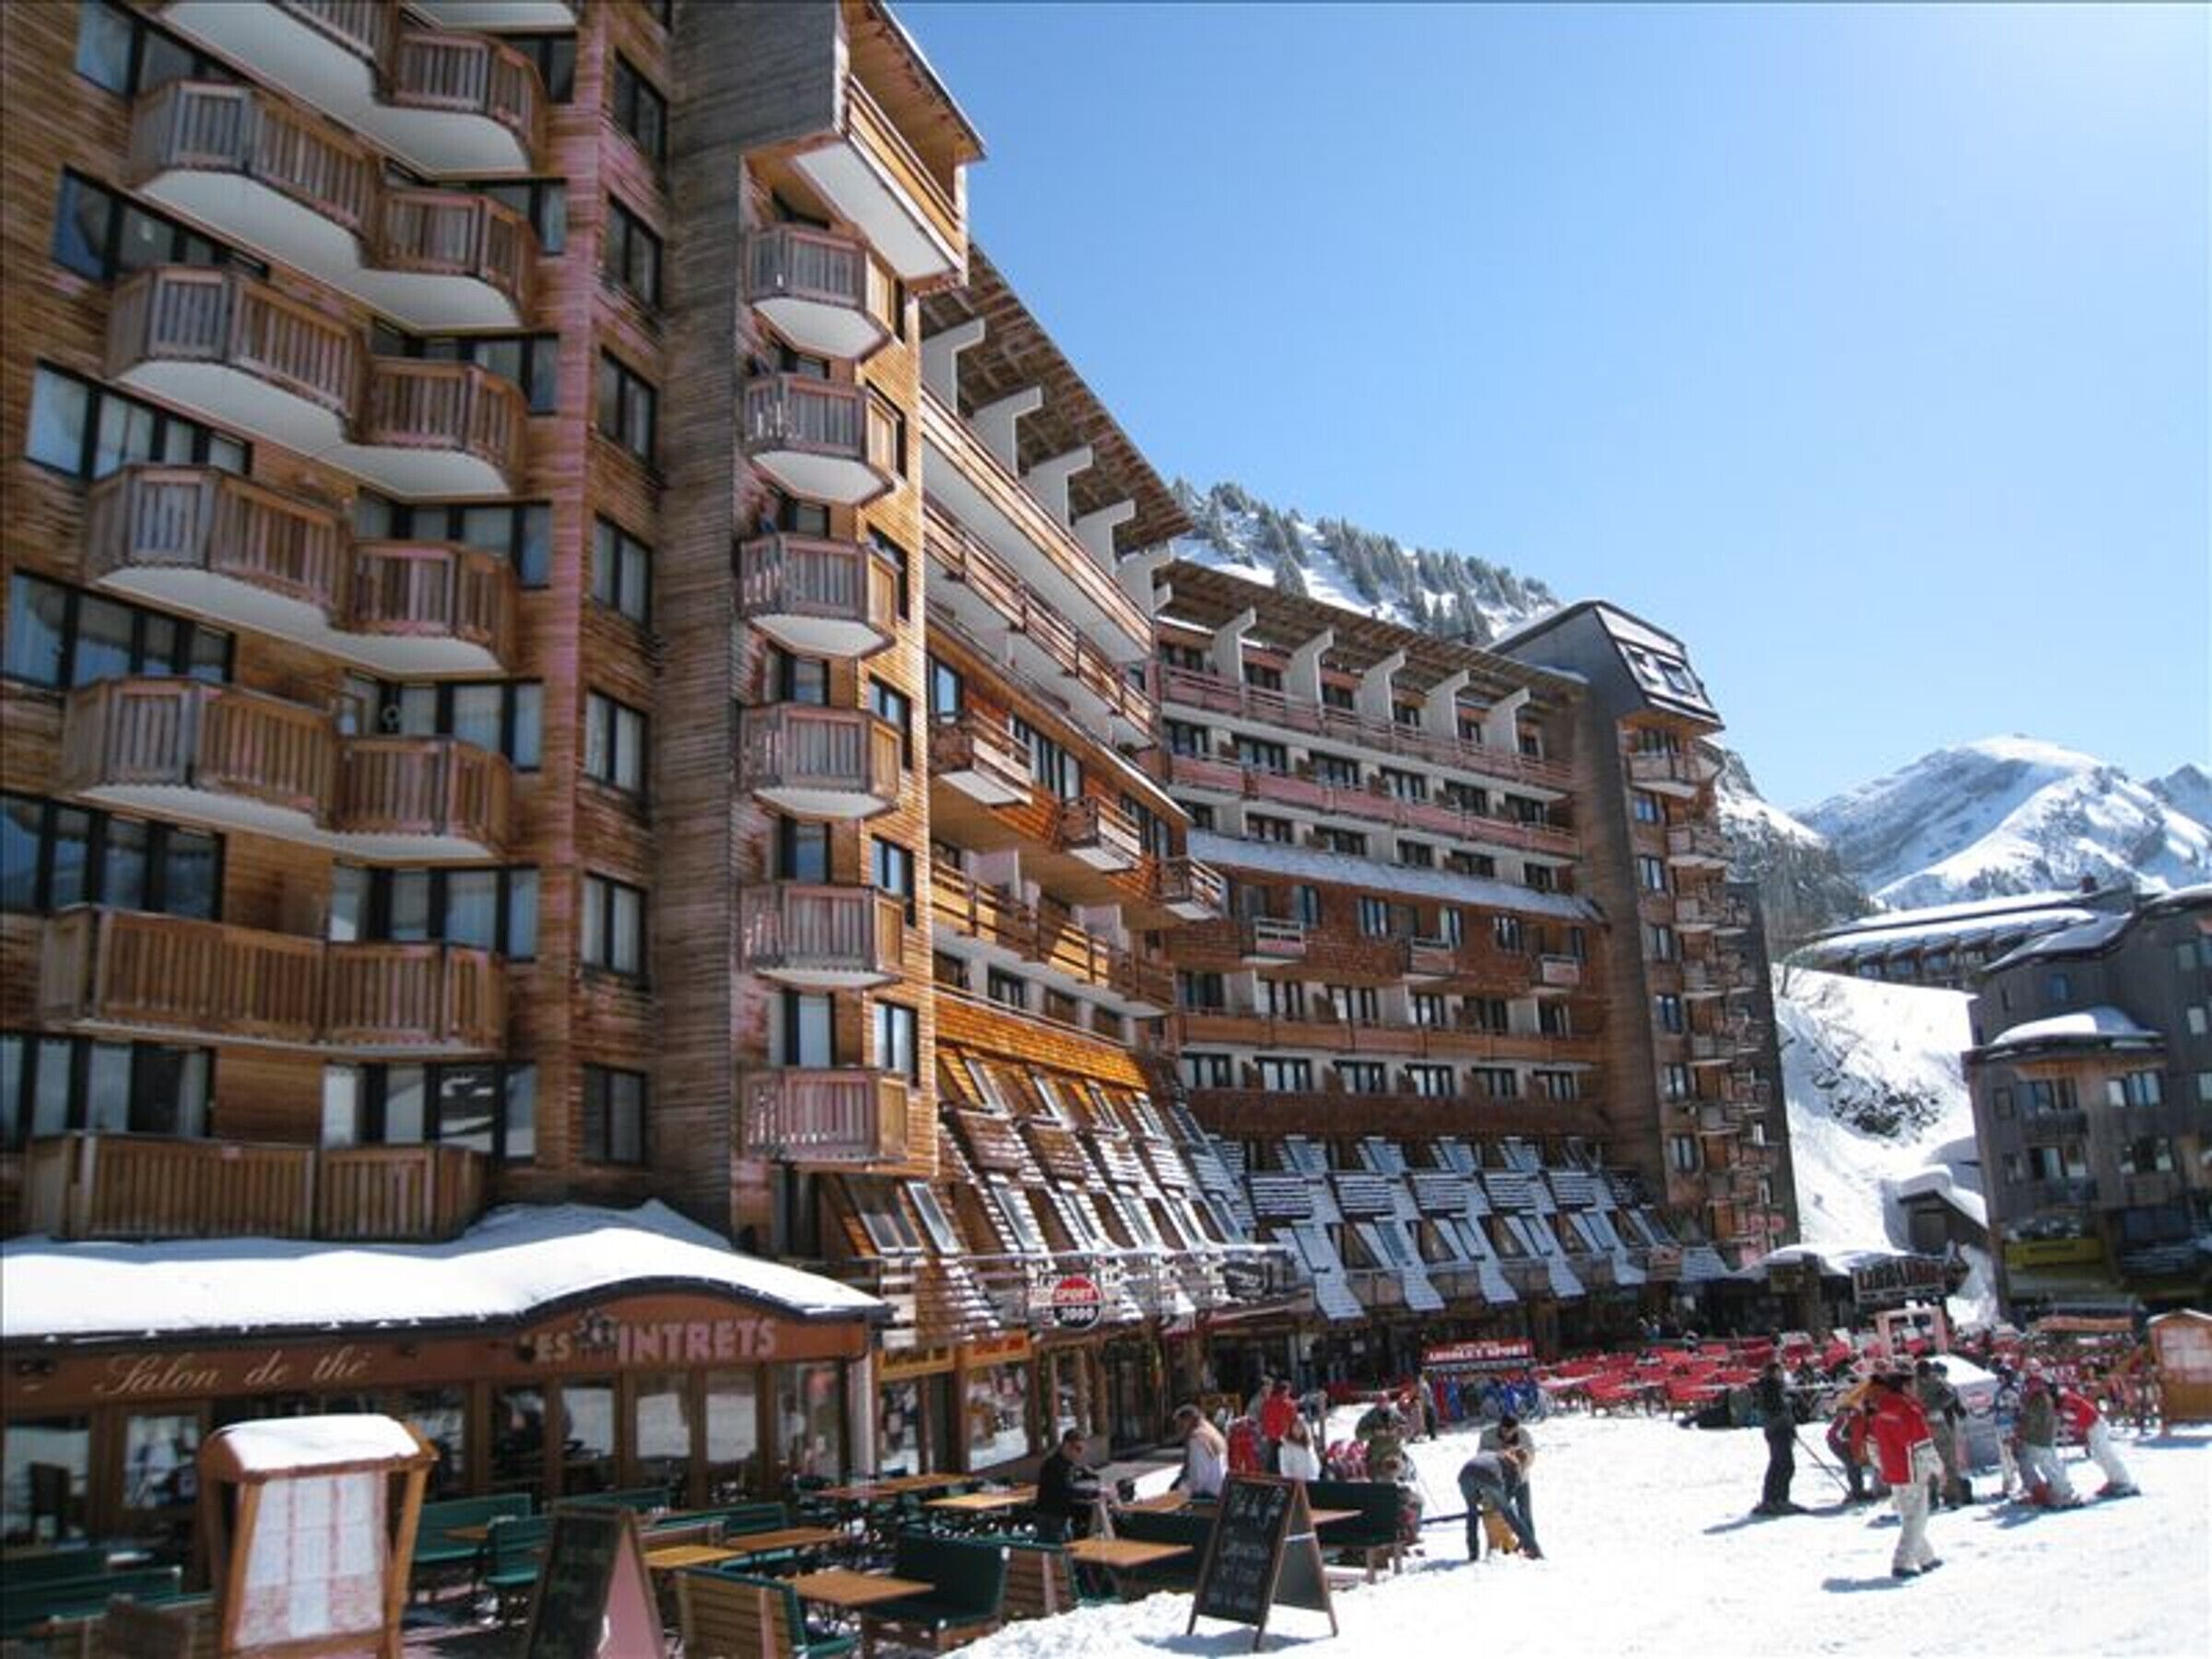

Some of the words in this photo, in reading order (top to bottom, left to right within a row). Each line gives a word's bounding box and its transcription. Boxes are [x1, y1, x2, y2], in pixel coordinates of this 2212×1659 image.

[617, 1319, 776, 1364] INTRETS
[92, 1351, 223, 1395] Salon
[242, 1349, 293, 1384] de
